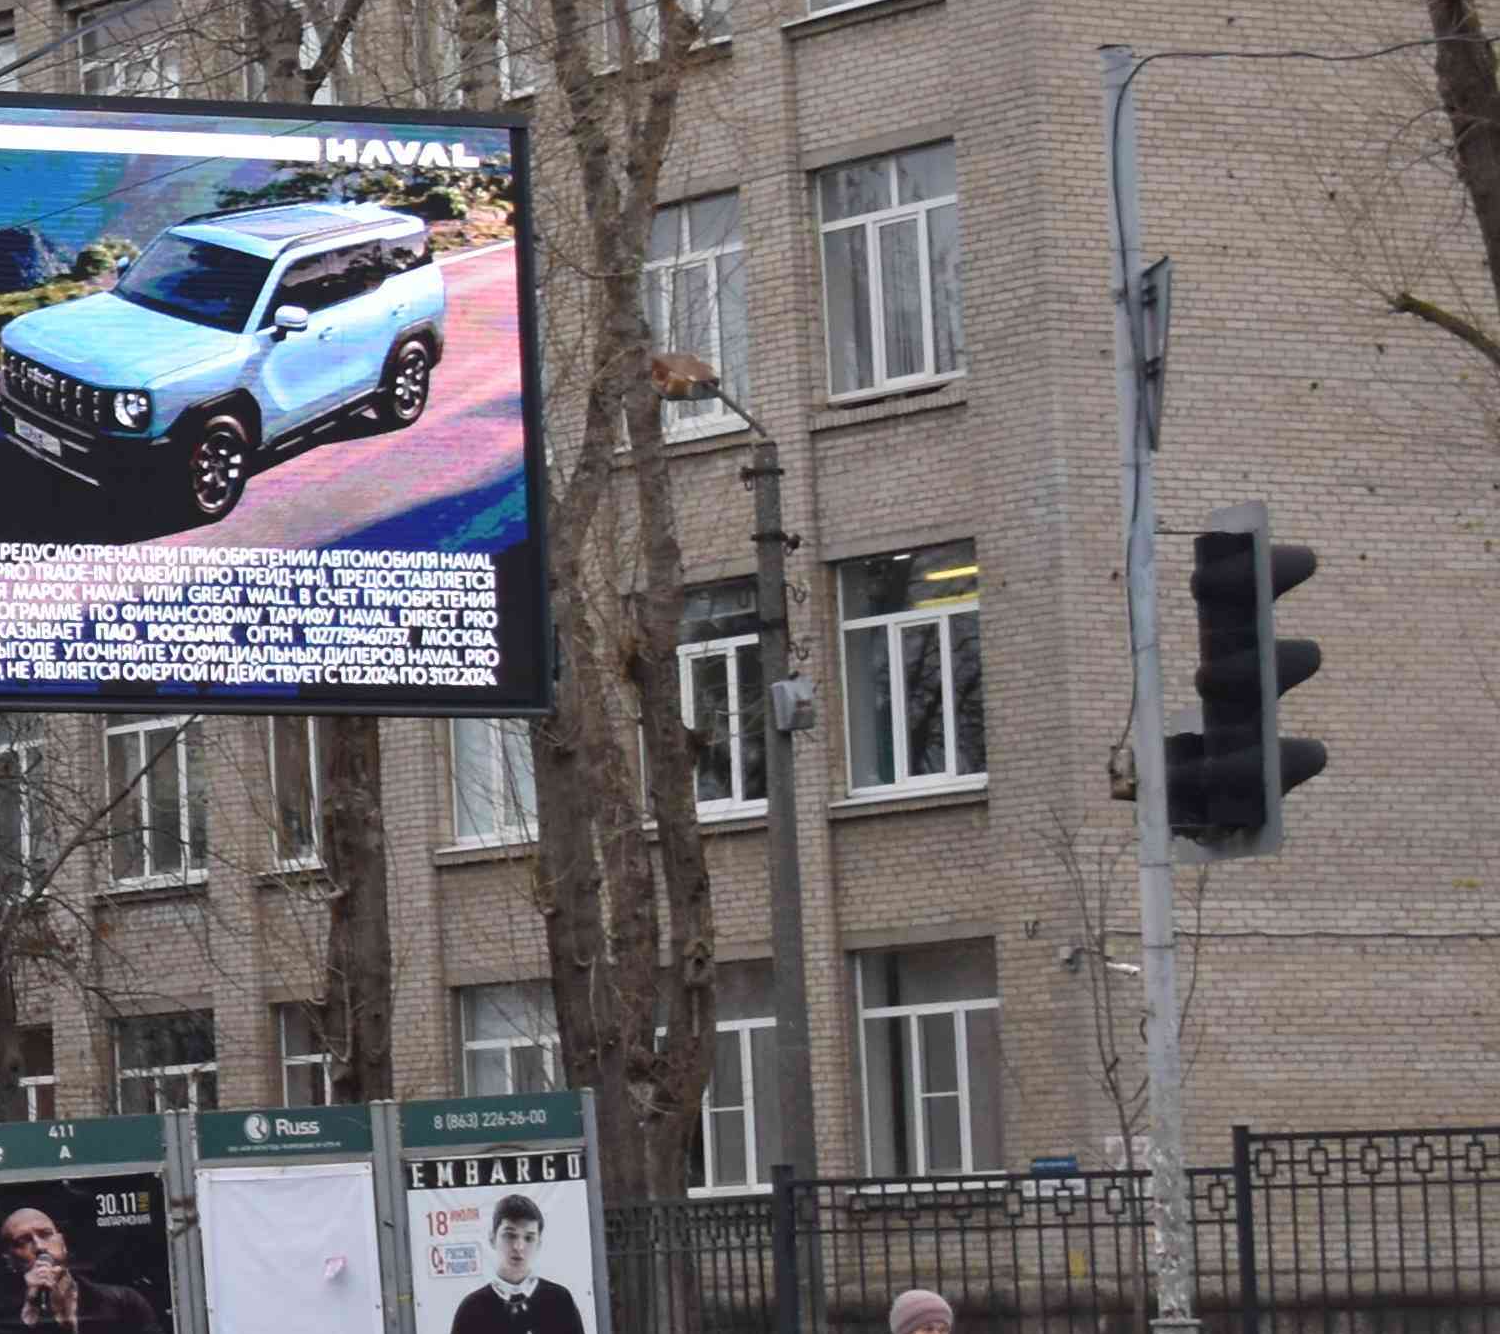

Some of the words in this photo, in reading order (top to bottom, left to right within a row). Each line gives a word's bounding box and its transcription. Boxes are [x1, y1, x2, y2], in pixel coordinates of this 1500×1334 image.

[326, 137, 479, 167] HAVAL
[141, 547, 179, 564] ПРИ
[181, 547, 317, 567] ПРИОБРЕТЕНИИ
[319, 550, 438, 569] АВТОМОБИЛЯ
[441, 553, 495, 570] HAVAL
[117, 560, 191, 586] (ХАВЕЙЛ
[196, 567, 232, 584] ПРО
[334, 569, 495, 592] ПРЕДОСТАВЛЯЕТСЯ
[12, 582, 76, 600] МАРОК
[82, 584, 139, 601] HAVAL
[143, 585, 182, 602] ИЛИ
[188, 586, 242, 603] GREAT
[247, 587, 294, 604] WALL
[300, 588, 311, 605] В
[315, 588, 358, 605] СЧЕТ
[364, 589, 496, 608] ПРИОБРЕТЕНИЯ
[89, 604, 116, 622] ПО
[121, 605, 262, 624] ФИНАНСОВОМУ
[267, 607, 335, 625] ТАРИФУ
[340, 608, 395, 626] HAVAL
[400, 609, 457, 627] DIRECT
[463, 611, 499, 628] PRO
[95, 624, 136, 641] ПАО
[246, 626, 293, 643] ОГРН
[63, 639, 166, 661] УТОЧНЯЙТЕ
[170, 644, 182, 661] У
[183, 645, 322, 667] ОФИЦИАЛЬНЫХ
[323, 647, 406, 668] ДИЛЕРОВ
[408, 648, 462, 666] HAVAL
[465, 649, 500, 666] PRO
[7, 661, 30, 679] НЕ
[34, 662, 121, 680] ЯВЛЯЕТСЯ
[122, 659, 209, 681] ОФЕРТОЙ
[211, 664, 225, 681] И
[226, 660, 323, 686] ДЕЙСТВУЕТ
[325, 666, 337, 683] С
[400, 667, 427, 684] ПО
[49, 1124, 75, 1138] 411
[275, 1118, 321, 1137] Russ
[433, 1115, 443, 1129] 8
[446, 1112, 478, 1130] (863)
[482, 1109, 547, 1127] 226-26-00
[411, 1153, 581, 1188] EMBARGO
[95, 1192, 137, 1216] 30.11
[426, 1210, 448, 1236] 18
